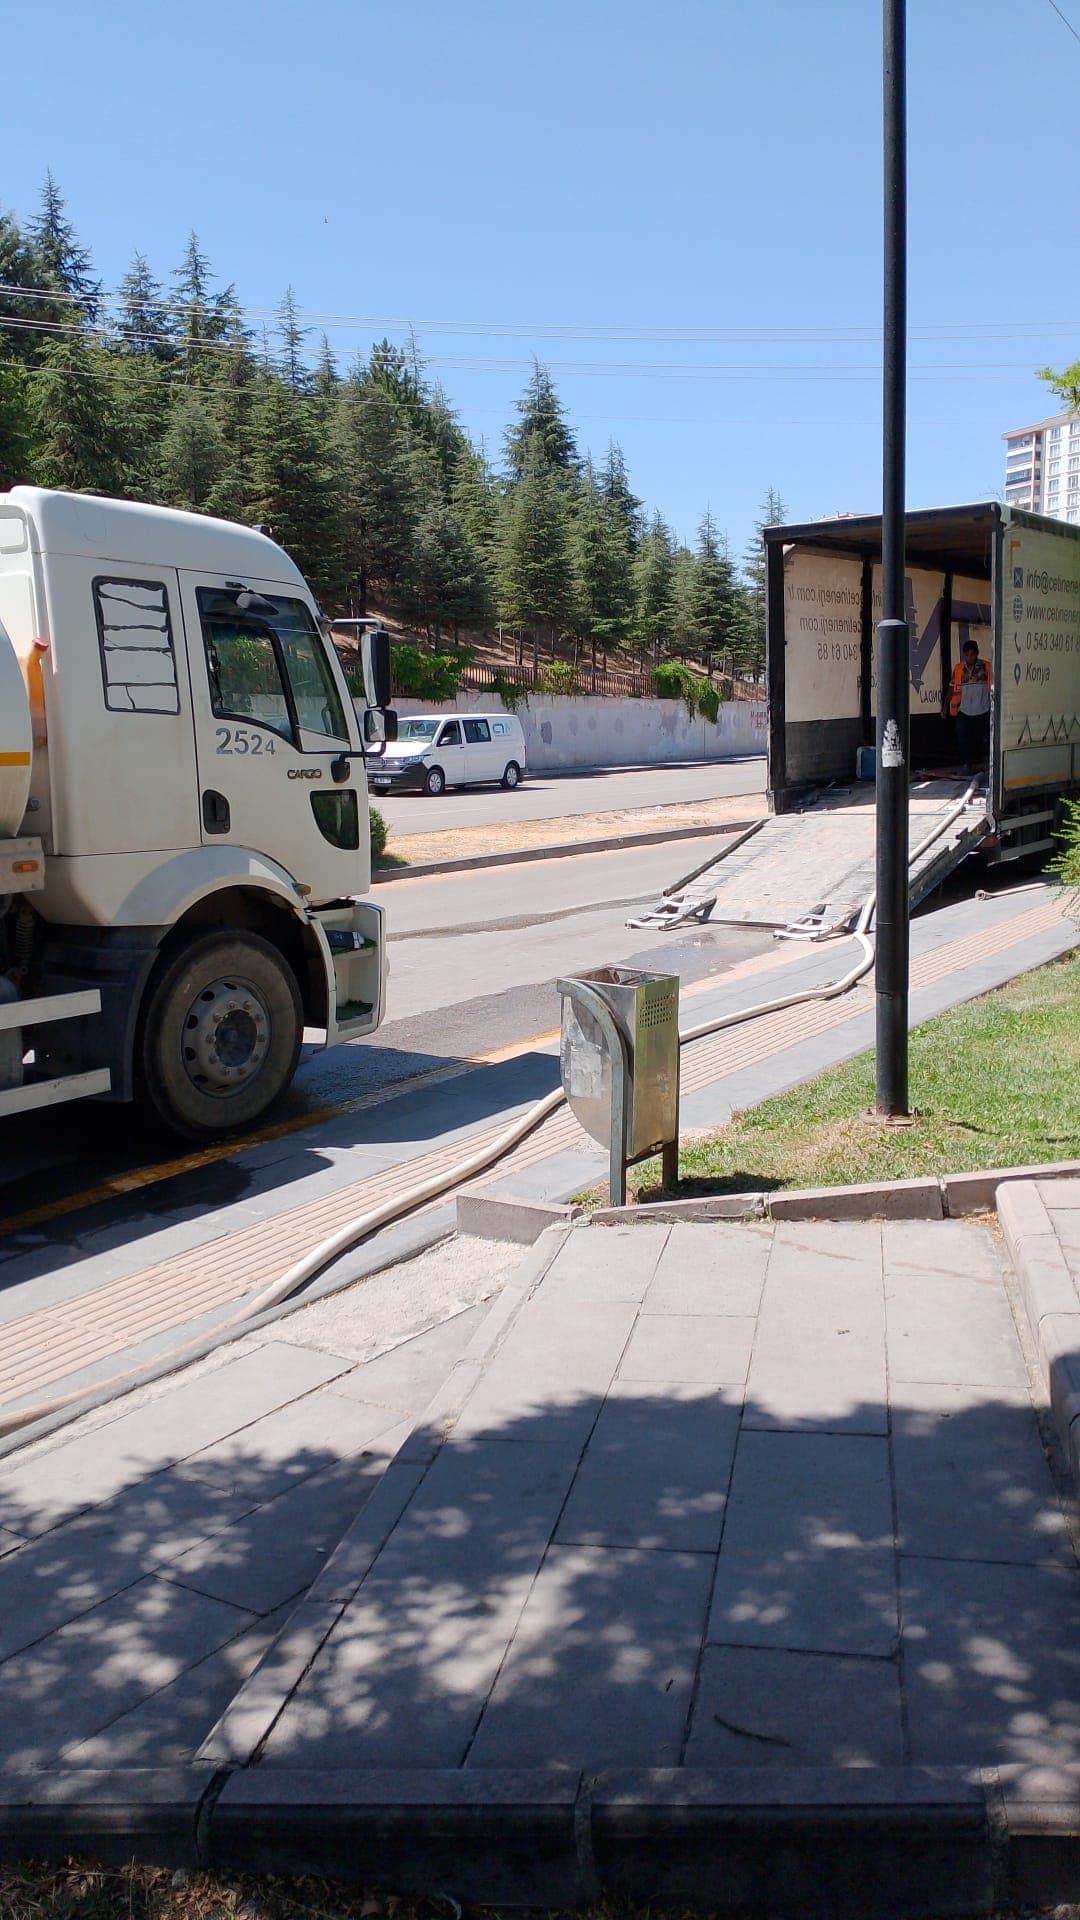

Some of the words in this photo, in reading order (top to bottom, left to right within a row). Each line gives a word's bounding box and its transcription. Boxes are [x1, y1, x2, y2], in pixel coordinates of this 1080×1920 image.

[1026, 632, 1031, 650] 0
[1033, 632, 1048, 651] 543
[1049, 633, 1063, 652] 340
[1065, 634, 1074, 652] 61
[1026, 662, 1050, 686] Konya
[215, 727, 276, 755] 2524
[287, 769, 323, 779] CARGO
